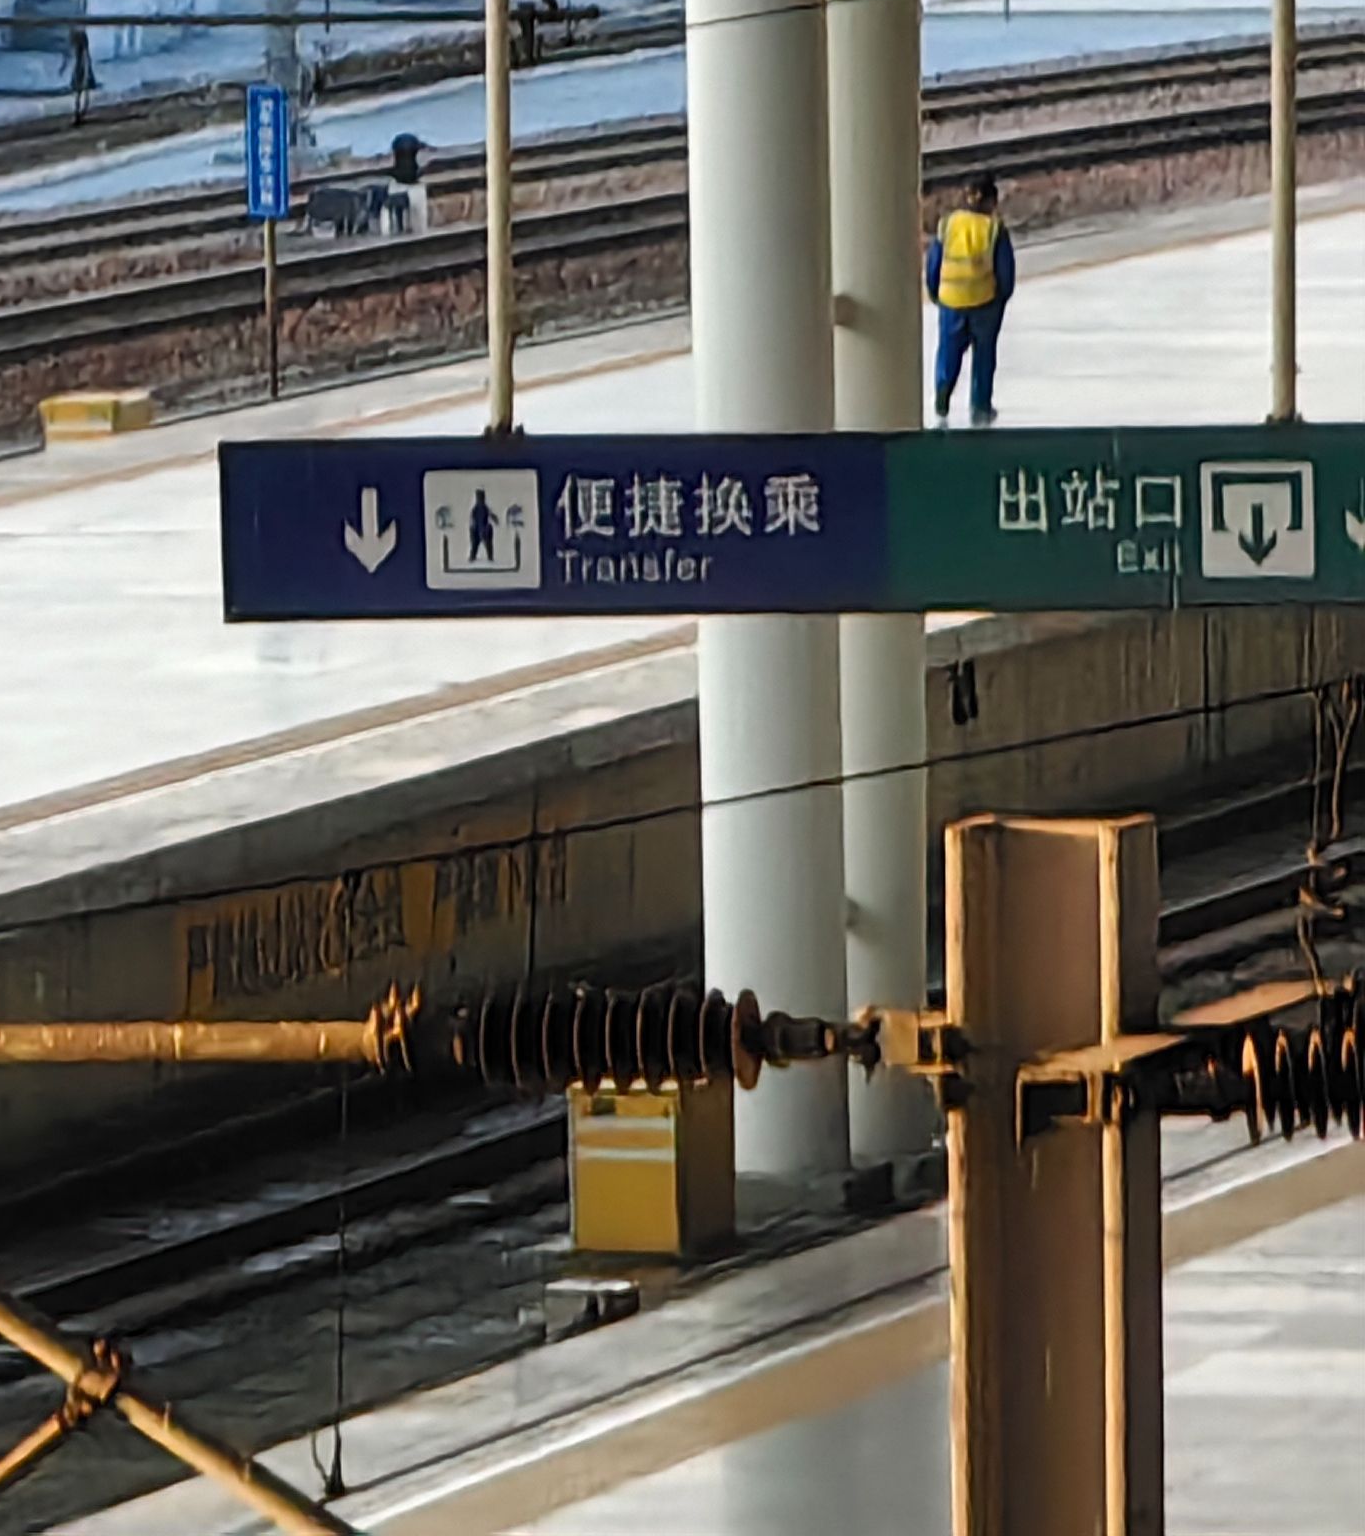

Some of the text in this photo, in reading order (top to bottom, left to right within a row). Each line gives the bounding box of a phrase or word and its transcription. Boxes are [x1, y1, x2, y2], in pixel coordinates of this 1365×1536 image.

[556, 470, 820, 539] 便捷换乘
[998, 464, 1183, 533] 出站口
[556, 547, 713, 584] Transfer
[1116, 538, 1183, 576] Exit
